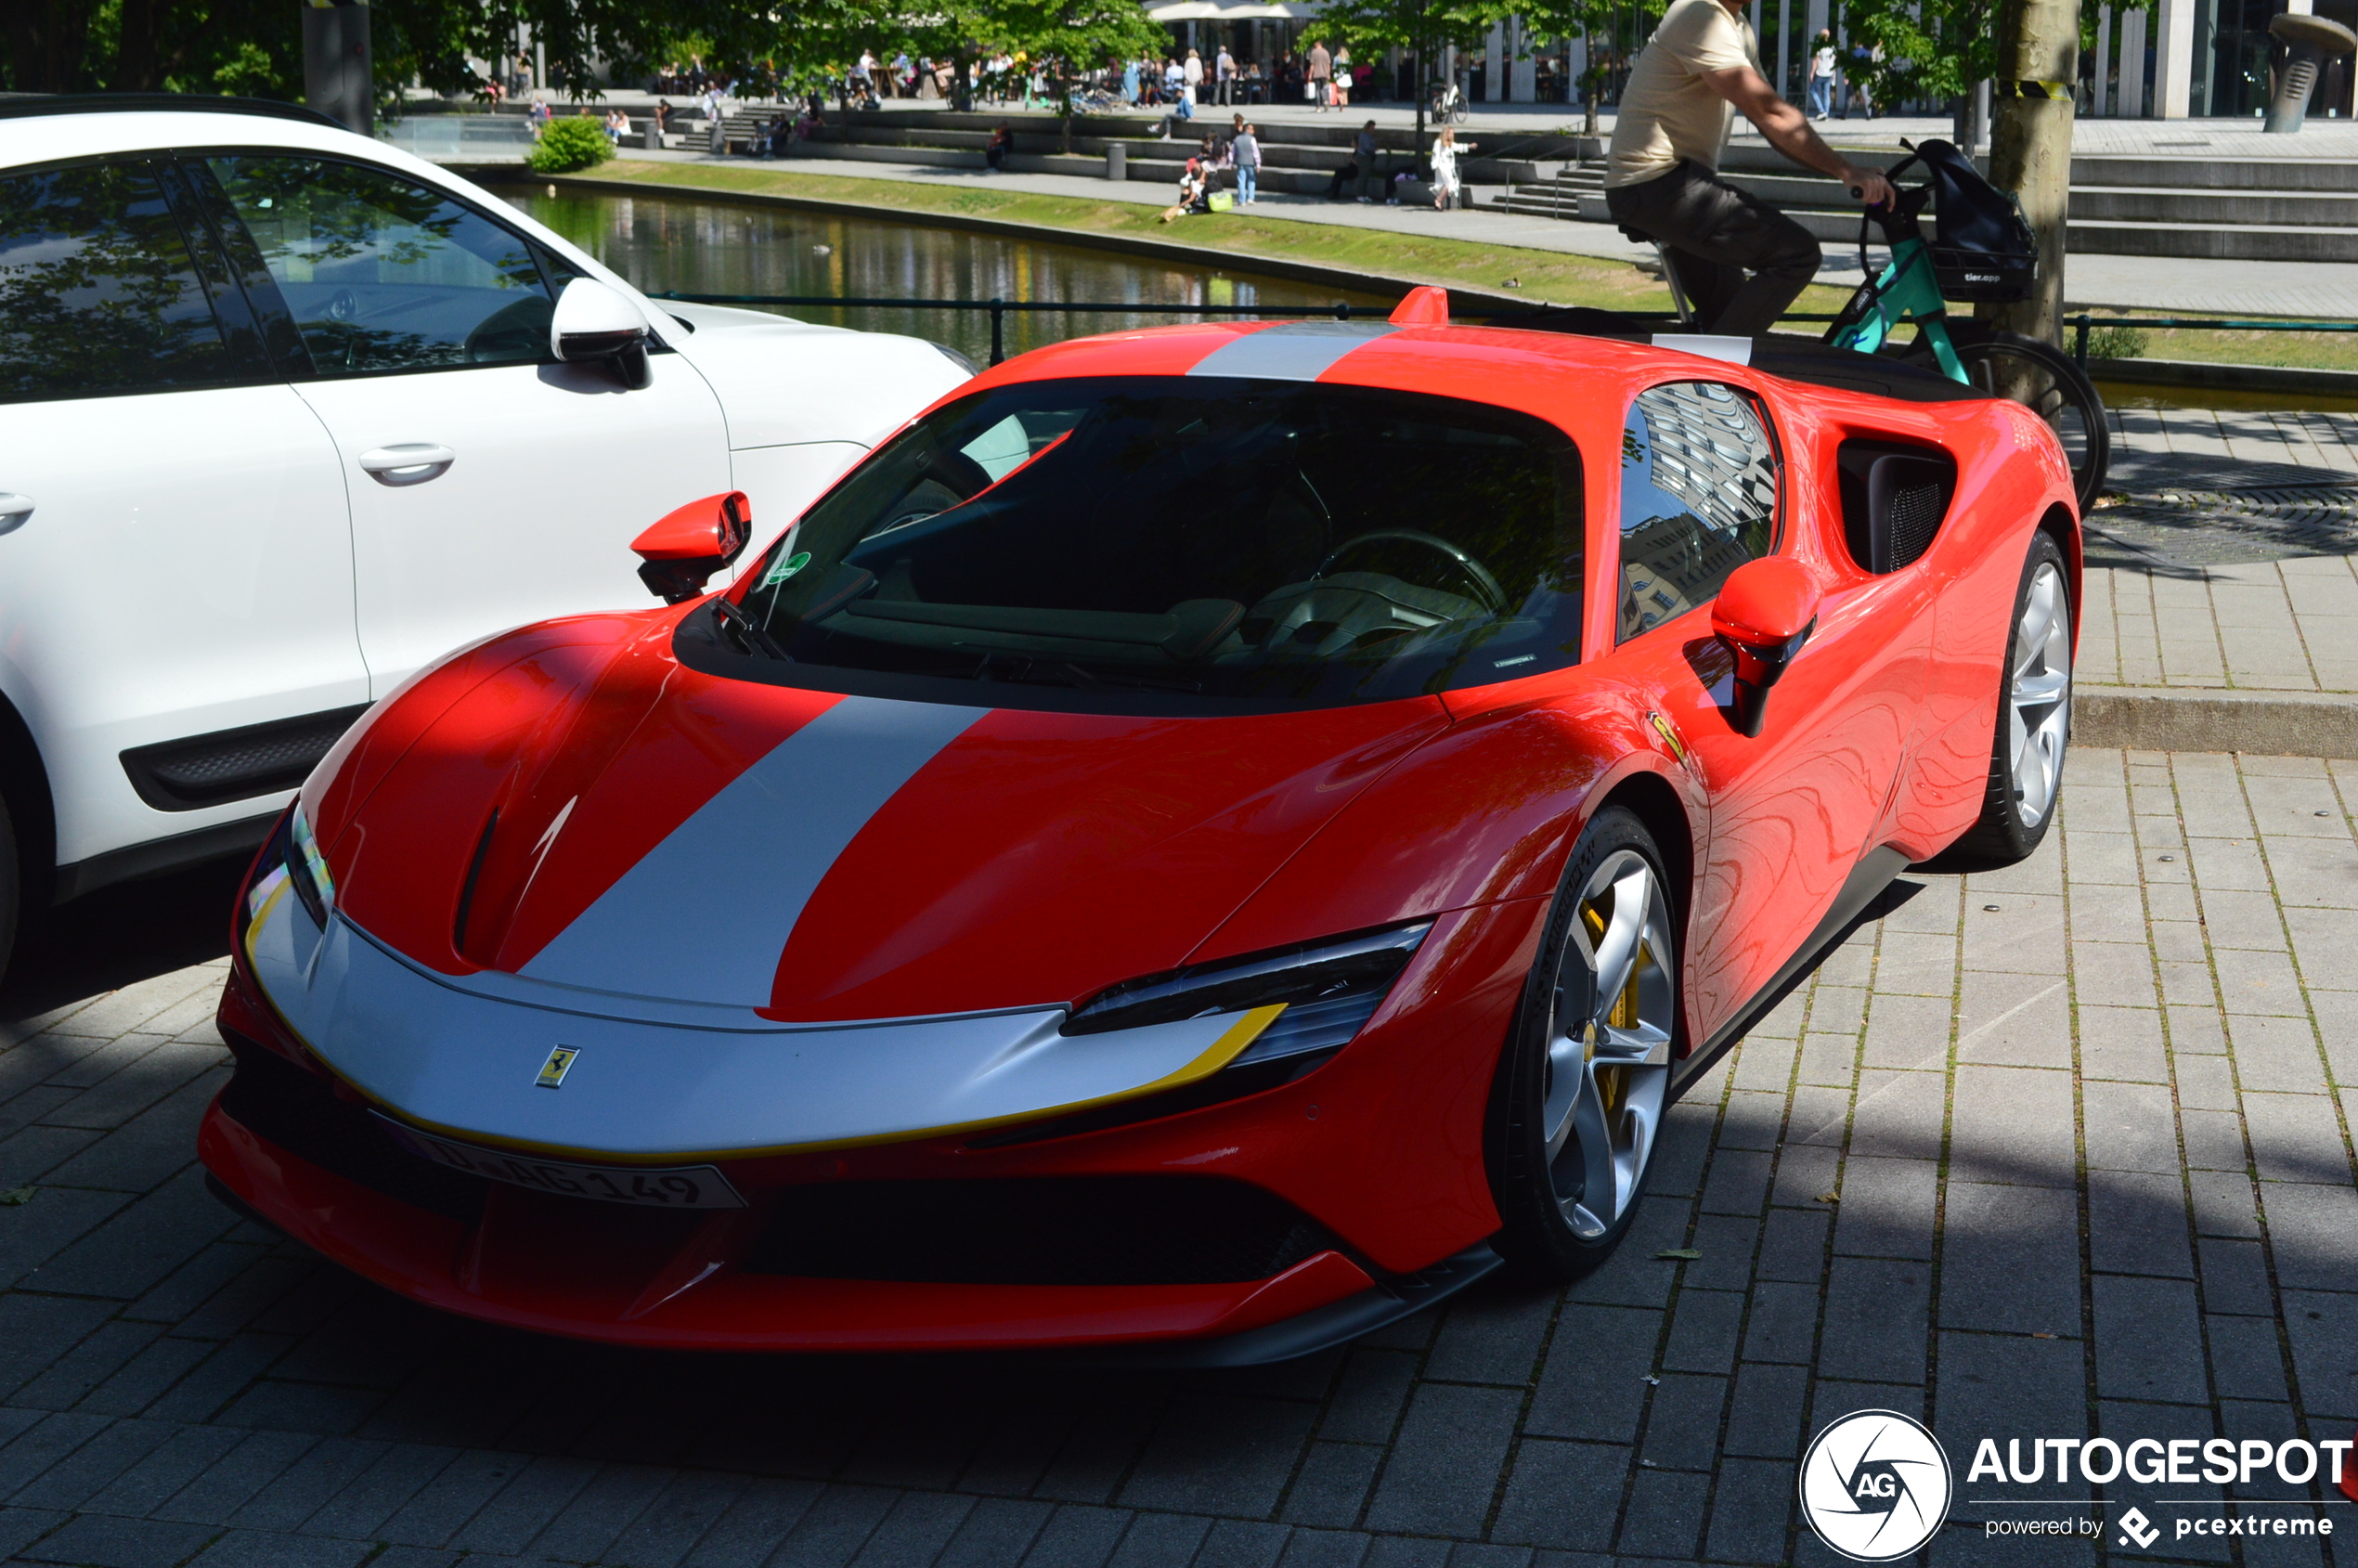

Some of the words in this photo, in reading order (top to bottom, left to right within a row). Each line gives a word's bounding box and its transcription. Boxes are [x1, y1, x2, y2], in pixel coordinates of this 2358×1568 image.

[1964, 273, 2001, 283] tier.app
[1548, 862, 1585, 951] MICHELIN
[585, 1172, 701, 1205] 149
